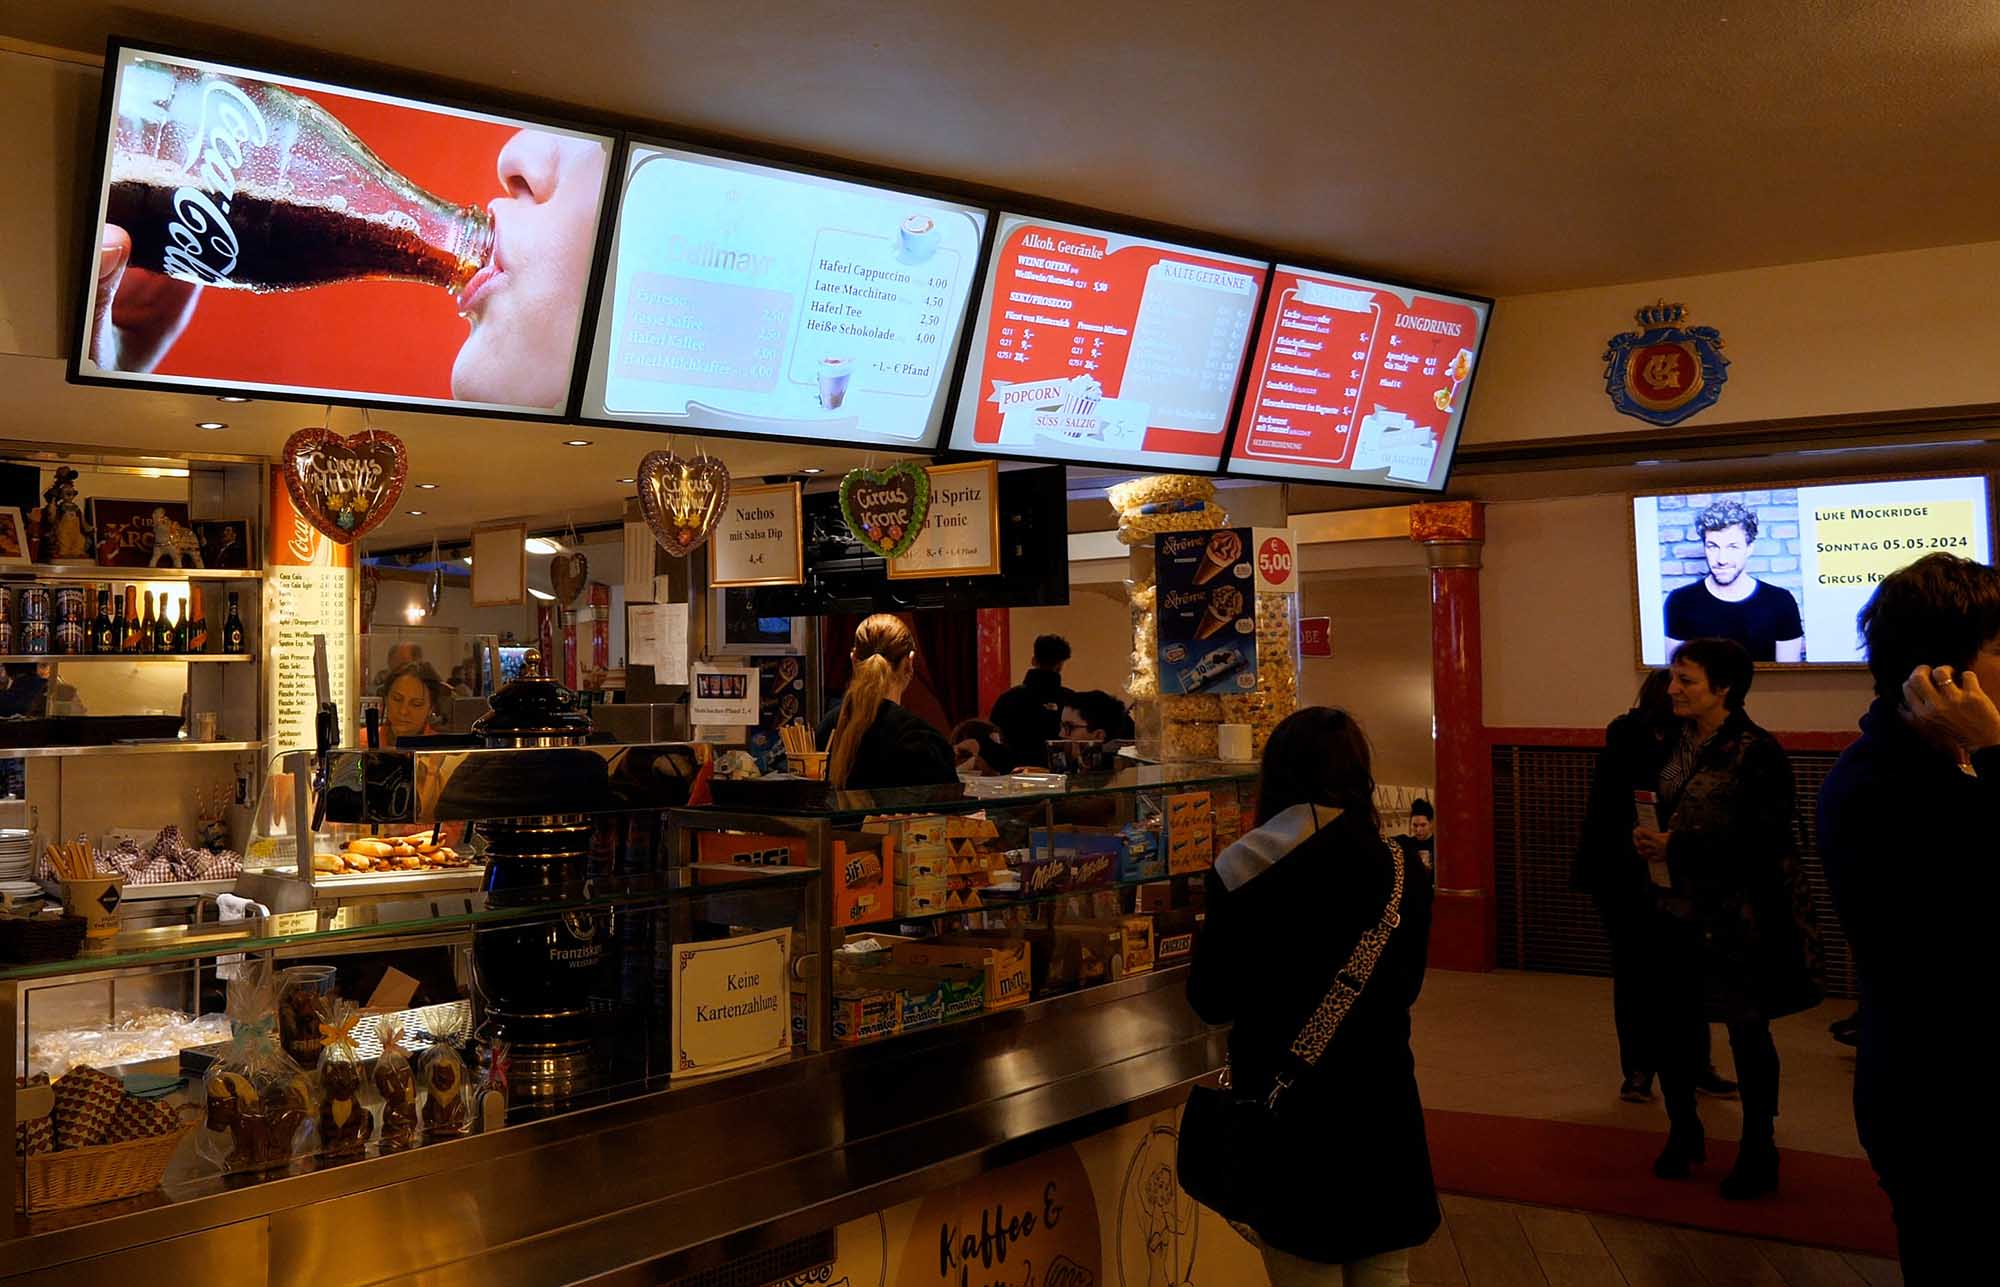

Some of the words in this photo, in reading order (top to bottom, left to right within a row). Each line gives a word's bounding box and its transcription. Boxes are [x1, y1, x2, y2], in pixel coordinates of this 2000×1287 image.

[1022, 234, 1056, 252] Alkoh.
[1058, 241, 1104, 260] Getränke
[819, 259, 851, 273] Haferl
[853, 265, 911, 284] Cappuccino
[1018, 255, 1045, 268] WEINE
[1045, 260, 1070, 272] OFFEN
[815, 280, 840, 293] Latte
[810, 301, 843, 315] Haferl
[846, 305, 862, 318] Tee
[807, 320, 838, 333] Heiße
[839, 324, 895, 341] Schokolade
[1394, 313, 1462, 336] LONGDRINKS
[902, 363, 930, 377] Pfand
[1003, 386, 1062, 405] POPCORN
[1065, 416, 1097, 429] SALZIG
[856, 487, 908, 510] Circus
[942, 486, 982, 507] Spritz
[736, 507, 775, 522] Nachos
[860, 508, 910, 530] Krone
[934, 512, 968, 529] Tonic
[729, 529, 743, 542] mit
[744, 529, 766, 541] Salsa
[768, 528, 783, 541] Dip
[1883, 536, 1968, 551] 05.05.2024
[1259, 553, 1291, 575] 5,00
[726, 970, 761, 993] Keine
[695, 995, 779, 1025] Kartenzahlung
[939, 1204, 1038, 1278] Kaffee
[1043, 1180, 1064, 1229] &
